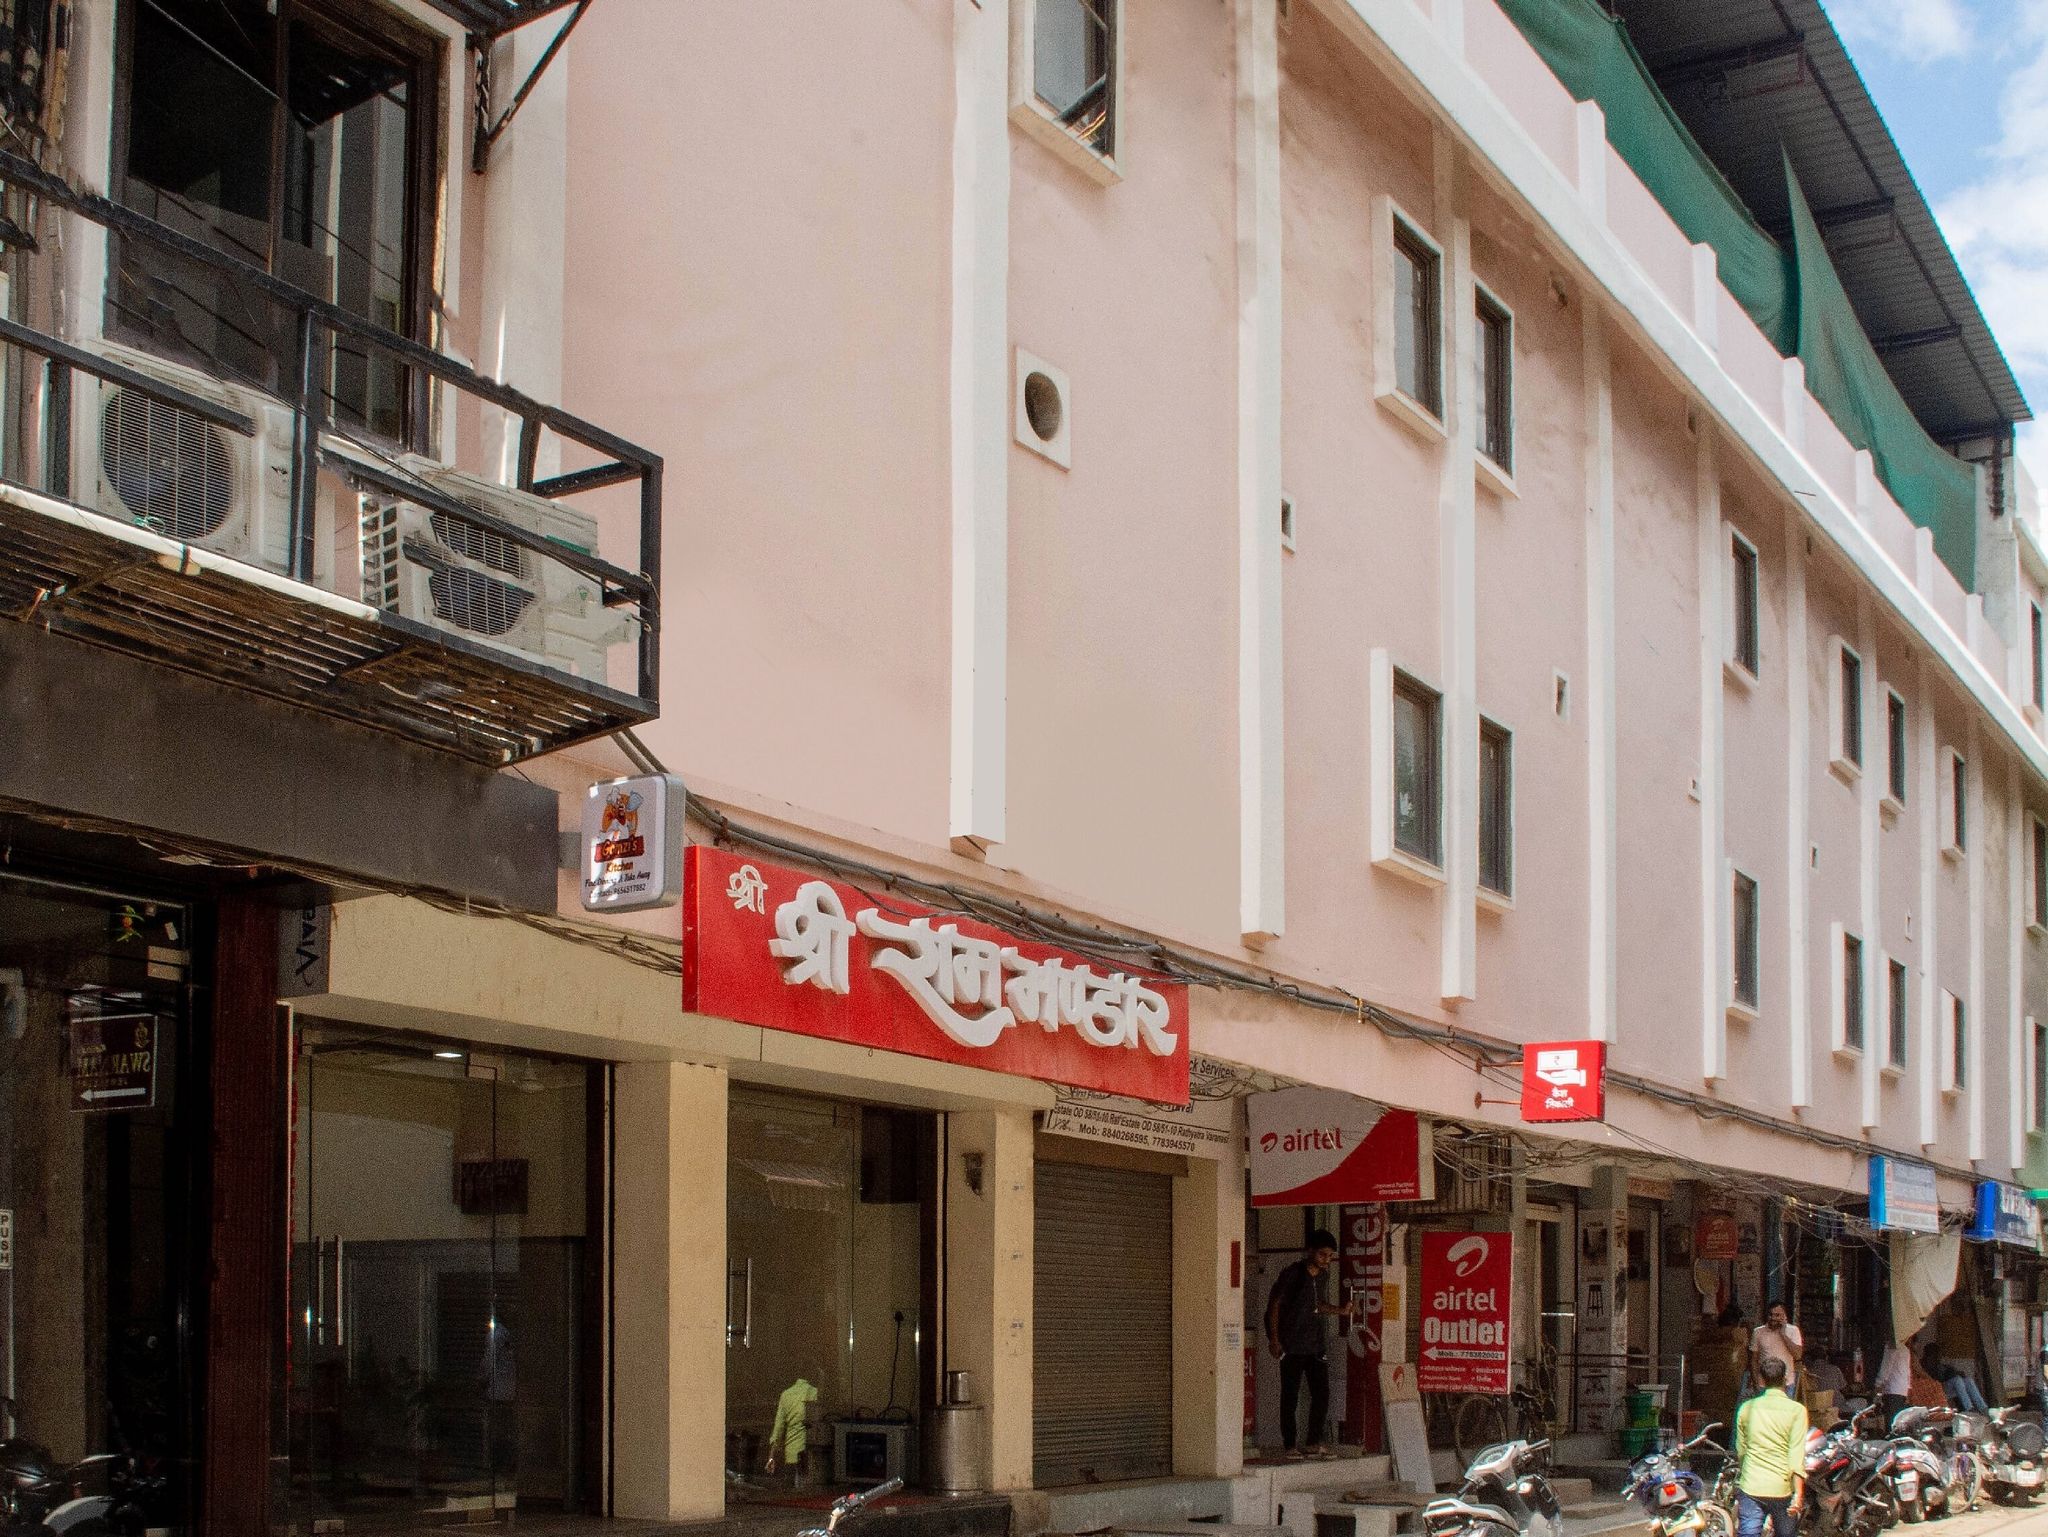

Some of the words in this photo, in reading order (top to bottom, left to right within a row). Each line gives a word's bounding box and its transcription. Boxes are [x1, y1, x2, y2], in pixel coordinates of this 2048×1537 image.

[726, 864, 768, 915] श्री
[768, 880, 857, 995] श्री
[857, 908, 1016, 1048] राम
[1200, 1060, 1236, 1080] Services
[1079, 1123, 1100, 1137] Mob:
[1283, 1128, 1343, 1152] airtel
[0, 1215, 9, 1264] PUSH
[1343, 1201, 1383, 1314] airtel
[1433, 1285, 1497, 1312] airtel
[1424, 1316, 1505, 1346] Outlet
